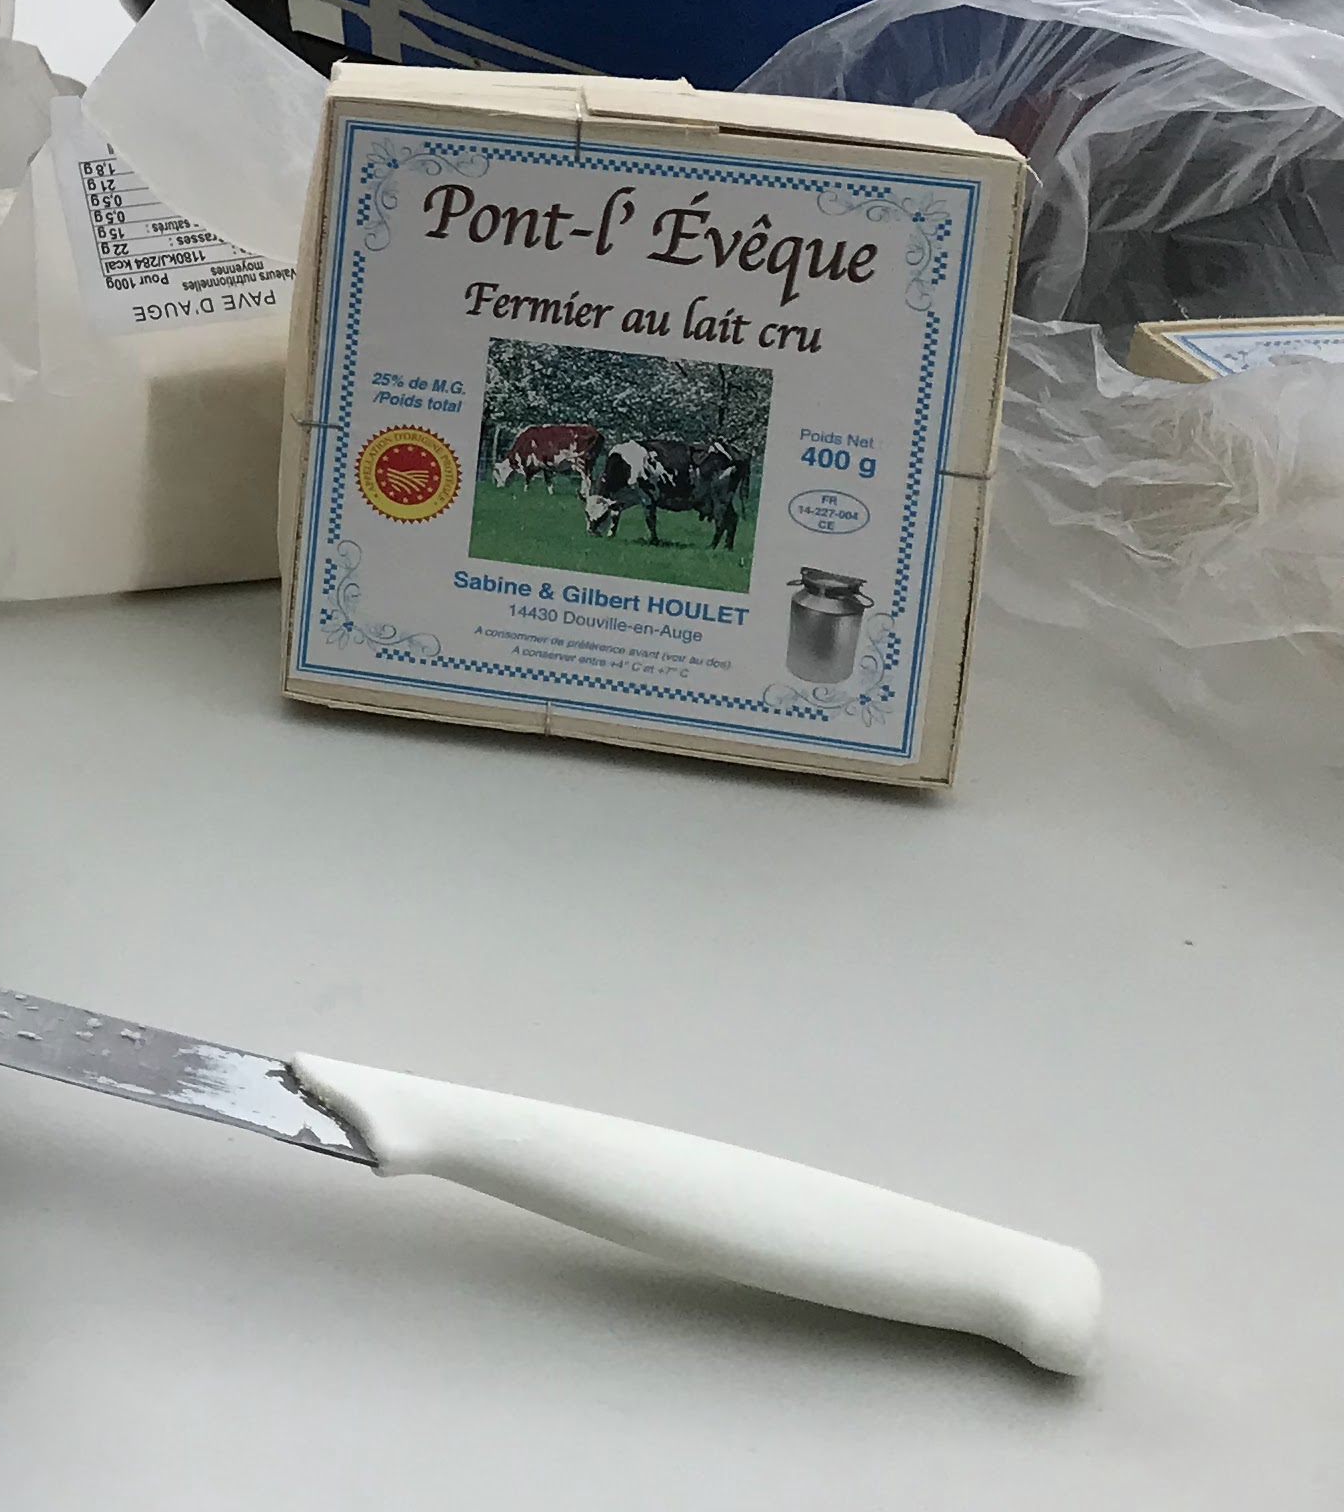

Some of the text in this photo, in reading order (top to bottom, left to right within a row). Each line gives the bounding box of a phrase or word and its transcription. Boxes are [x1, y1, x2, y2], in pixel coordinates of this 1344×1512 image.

[83, 162, 116, 176] 1,8 g
[87, 178, 116, 192] 21 g
[90, 194, 123, 208] 0,5 g
[94, 210, 126, 224] 0,5 g
[97, 226, 107, 239] g
[109, 227, 126, 240] 15
[100, 241, 110, 254] g
[113, 243, 130, 256] 22
[647, 190, 879, 307] Évêque
[105, 250, 206, 274] 1180kJ/284 kcal
[210, 260, 265, 276] moyennes
[105, 273, 170, 291] Pour 100g
[182, 268, 297, 292] Valeurs nutritionnelles
[132, 289, 277, 322] PAVE D'AUGE
[464, 281, 822, 354] Fermier au lait cru
[371, 372, 466, 395] 25% de M.G.
[372, 391, 463, 413] /Poids total
[799, 428, 843, 445] Poids
[800, 446, 876, 478] 400 g
[821, 494, 838, 506] FR
[817, 520, 836, 531] CE
[452, 569, 750, 626] Sabine & Gilbert HOULET
[509, 603, 703, 643] 14430 Douville-en-Auge
